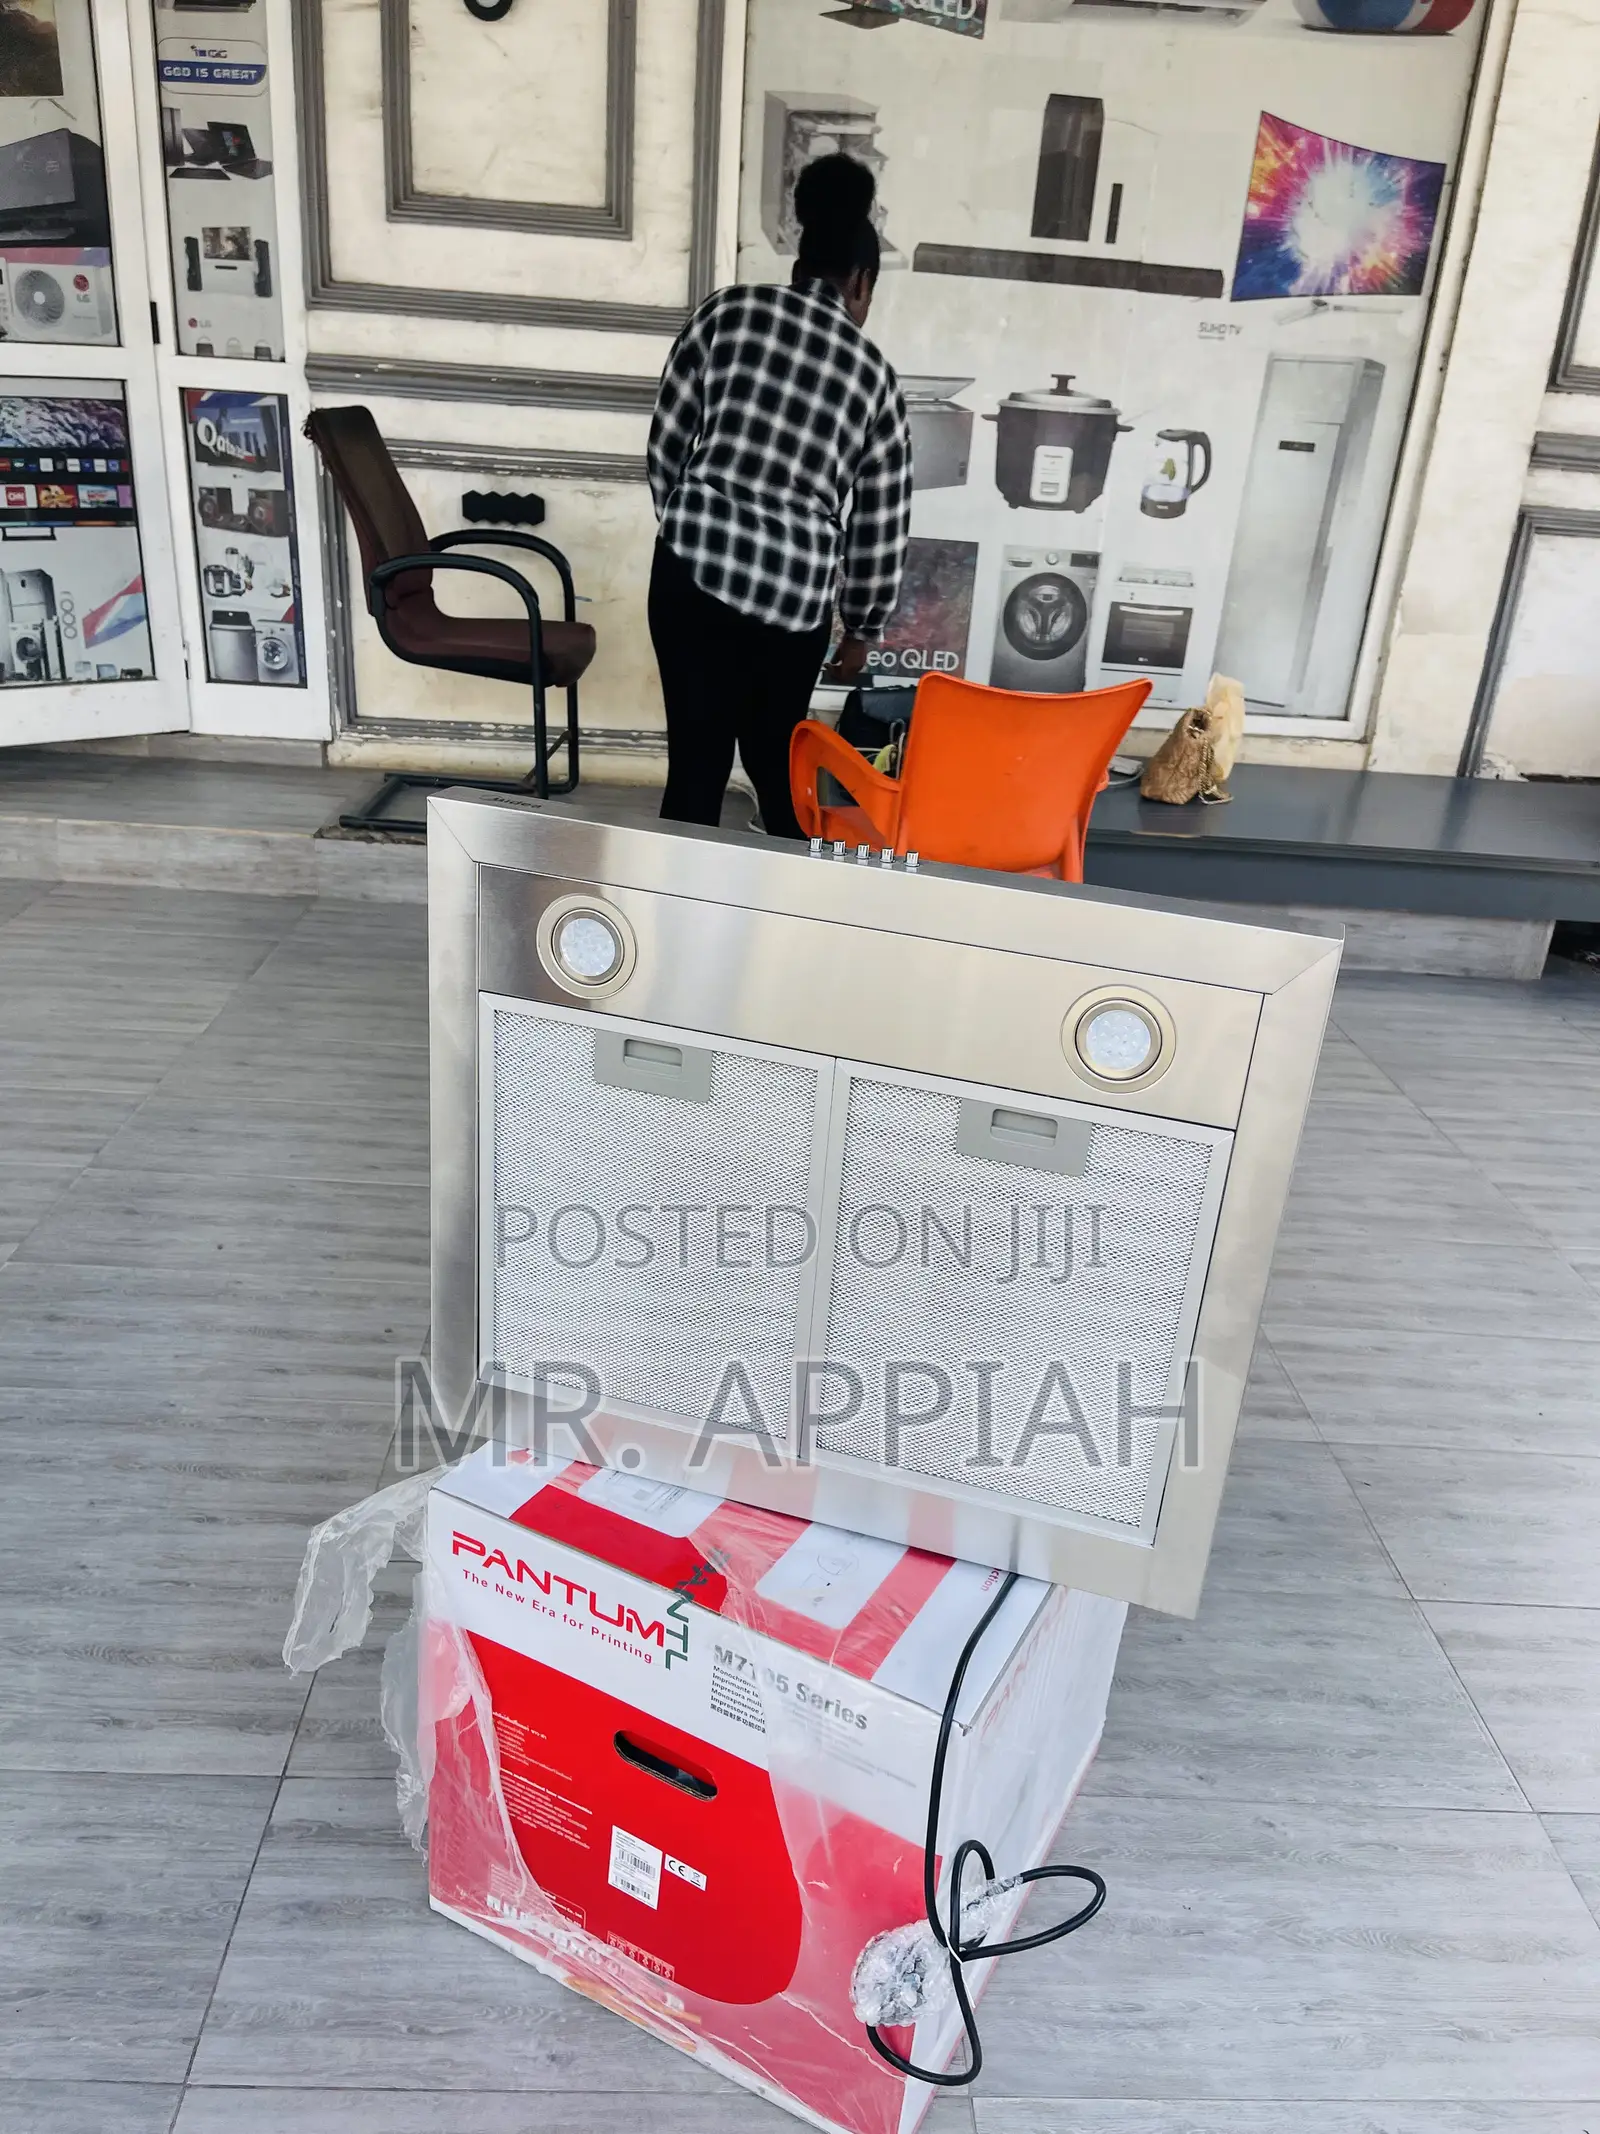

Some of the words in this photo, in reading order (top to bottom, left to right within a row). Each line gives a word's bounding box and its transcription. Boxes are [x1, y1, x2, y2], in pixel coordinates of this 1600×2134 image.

[163, 66, 191, 77] GOD
[195, 68, 209, 78] IS
[213, 69, 257, 80] GREAT
[866, 650, 896, 667] eo
[900, 649, 959, 671] QLED
[453, 1531, 665, 1648] PANTUM
[462, 1569, 489, 1588] The
[495, 1583, 526, 1604] New
[532, 1599, 556, 1618] Era
[563, 1613, 584, 1630] for
[591, 1626, 653, 1665] Printing
[796, 1682, 868, 1731] Series
